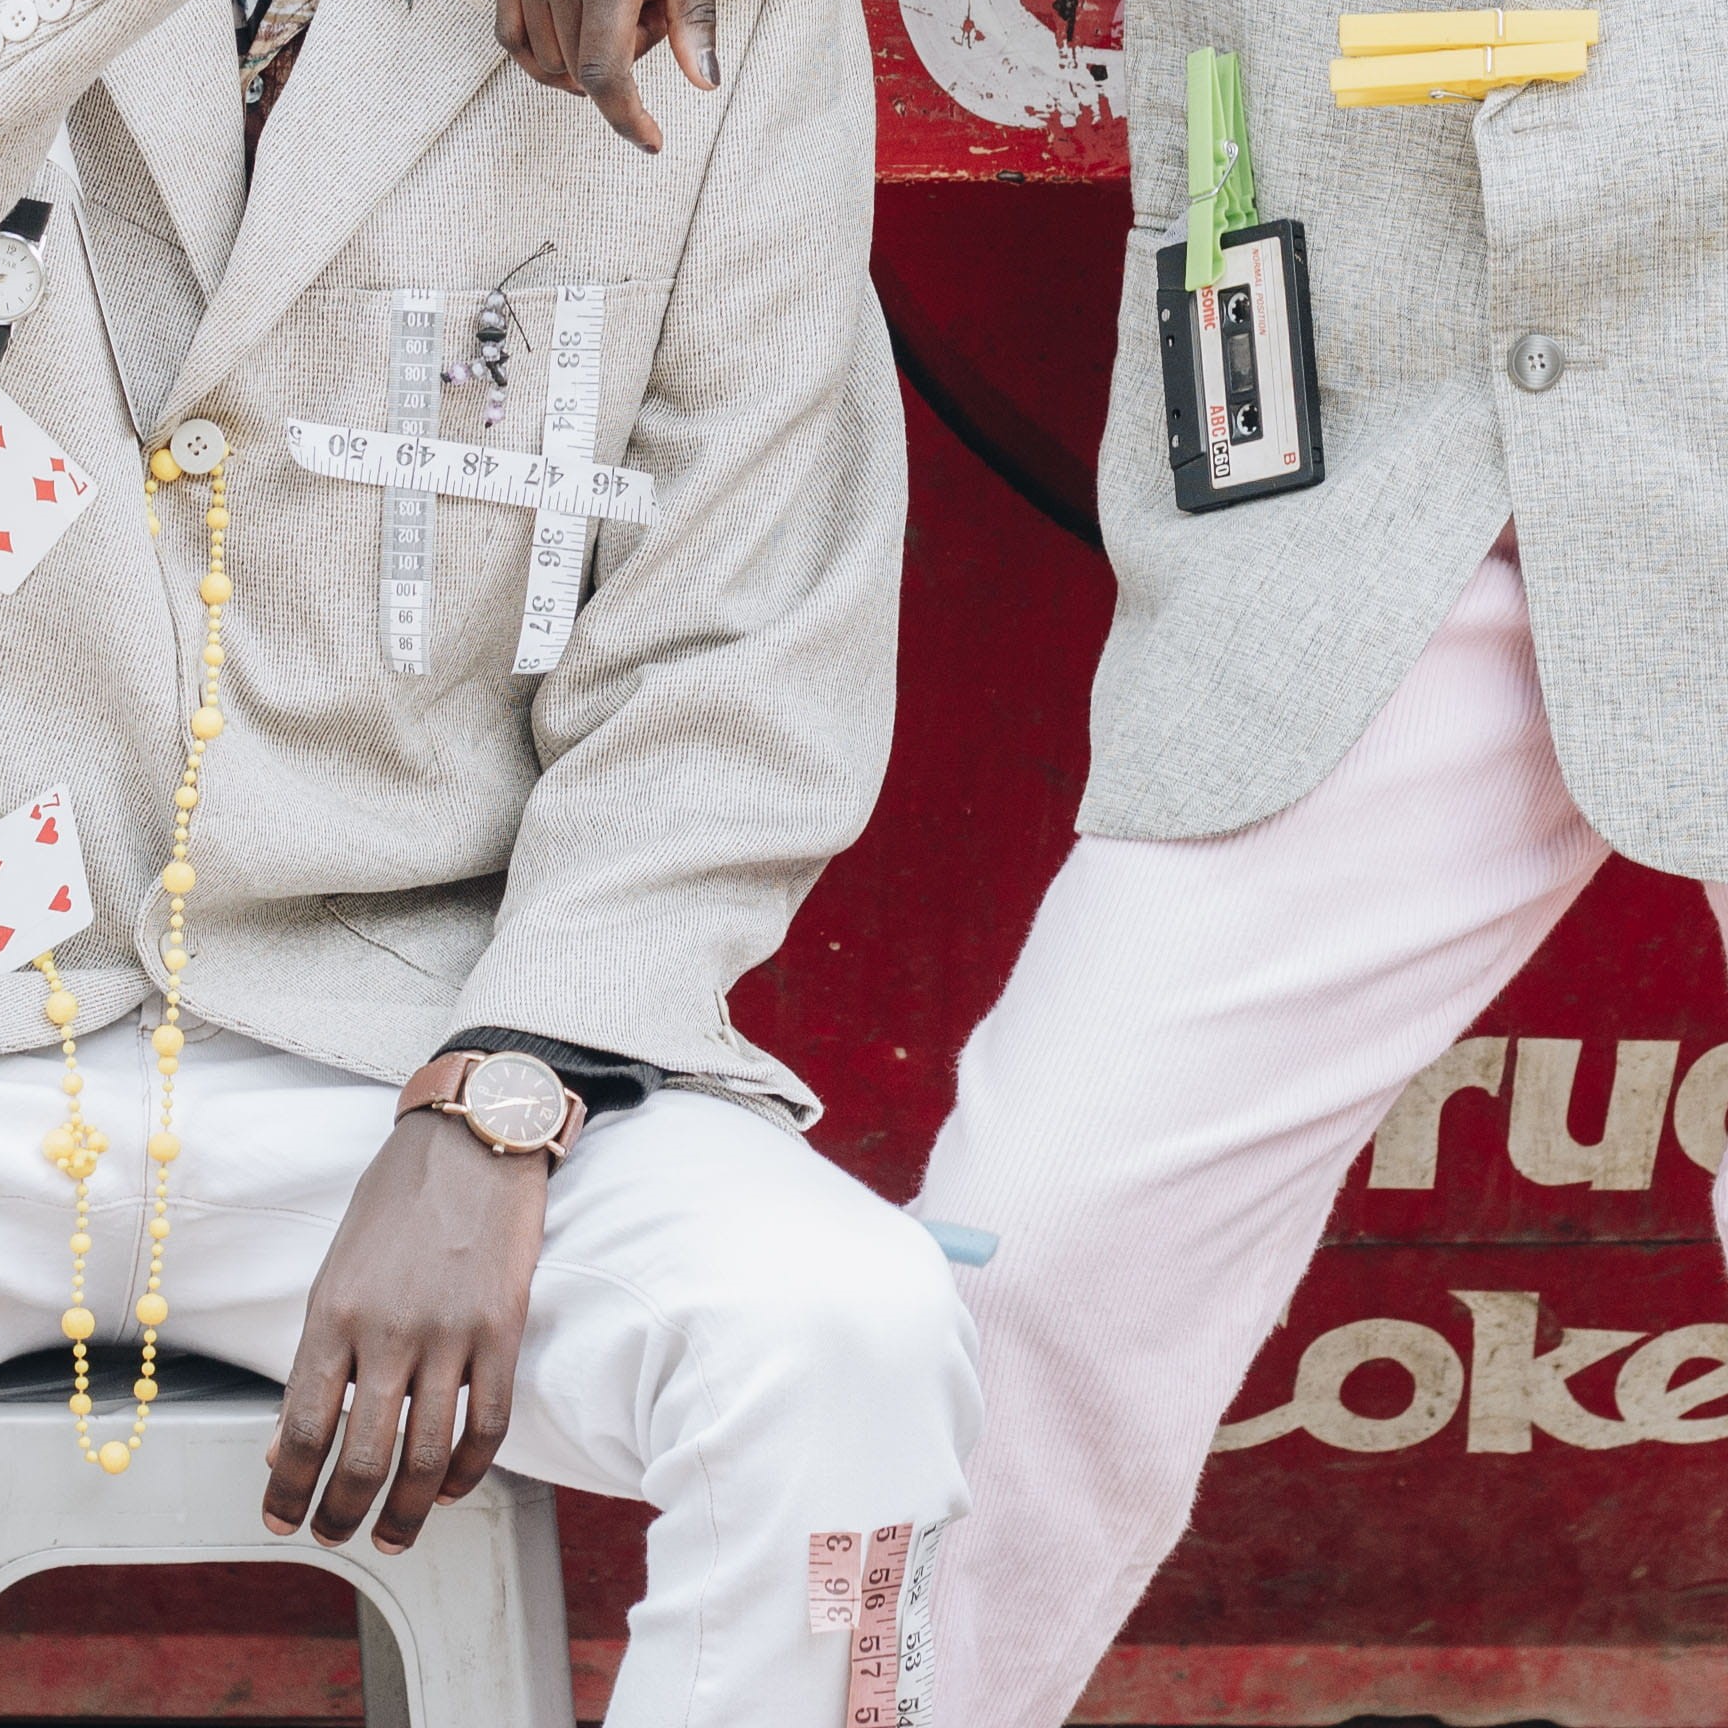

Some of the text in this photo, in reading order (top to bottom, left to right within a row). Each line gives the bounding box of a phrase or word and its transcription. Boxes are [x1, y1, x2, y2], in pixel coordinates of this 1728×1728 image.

[406, 312, 430, 327] 110
[405, 340, 430, 355] 109
[402, 394, 428, 408] 107
[1209, 405, 1227, 437] ABC
[1213, 441, 1230, 477] C60
[1284, 451, 1296, 466] B
[399, 501, 423, 516] 103
[397, 528, 422, 543] 102
[396, 555, 420, 569] 101
[396, 582, 417, 597] 100
[398, 610, 414, 624] 99
[398, 637, 413, 650] 98
